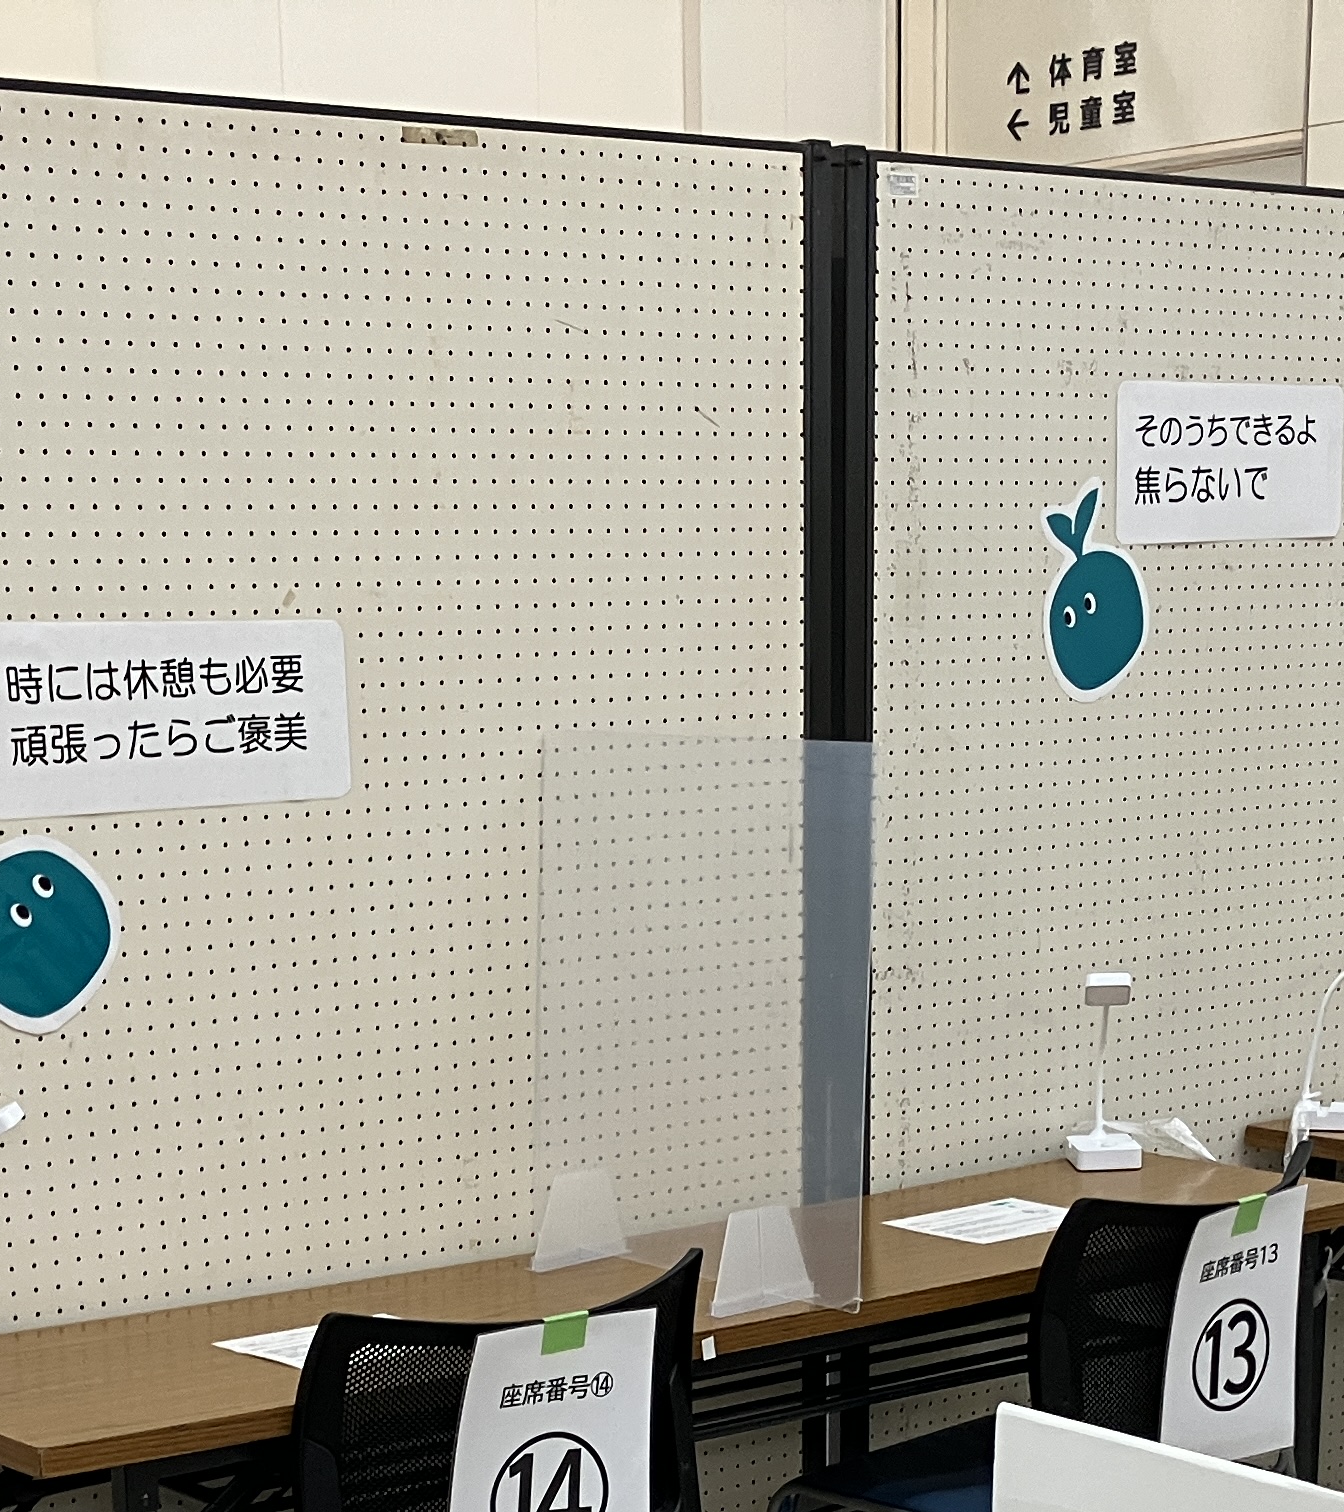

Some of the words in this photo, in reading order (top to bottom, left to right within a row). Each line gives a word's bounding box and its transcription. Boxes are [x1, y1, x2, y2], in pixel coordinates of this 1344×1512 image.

[1048, 40, 1138, 88] 体育室
[1048, 89, 1136, 137] 児童室
[1135, 413, 1317, 448] そのうちできるよ
[1134, 465, 1269, 506] 焦らないで
[5, 654, 304, 705] 時には休憩も必要
[10, 711, 308, 767] 頑張ったらご褒美
[1199, 1242, 1279, 1284] 座席番号13
